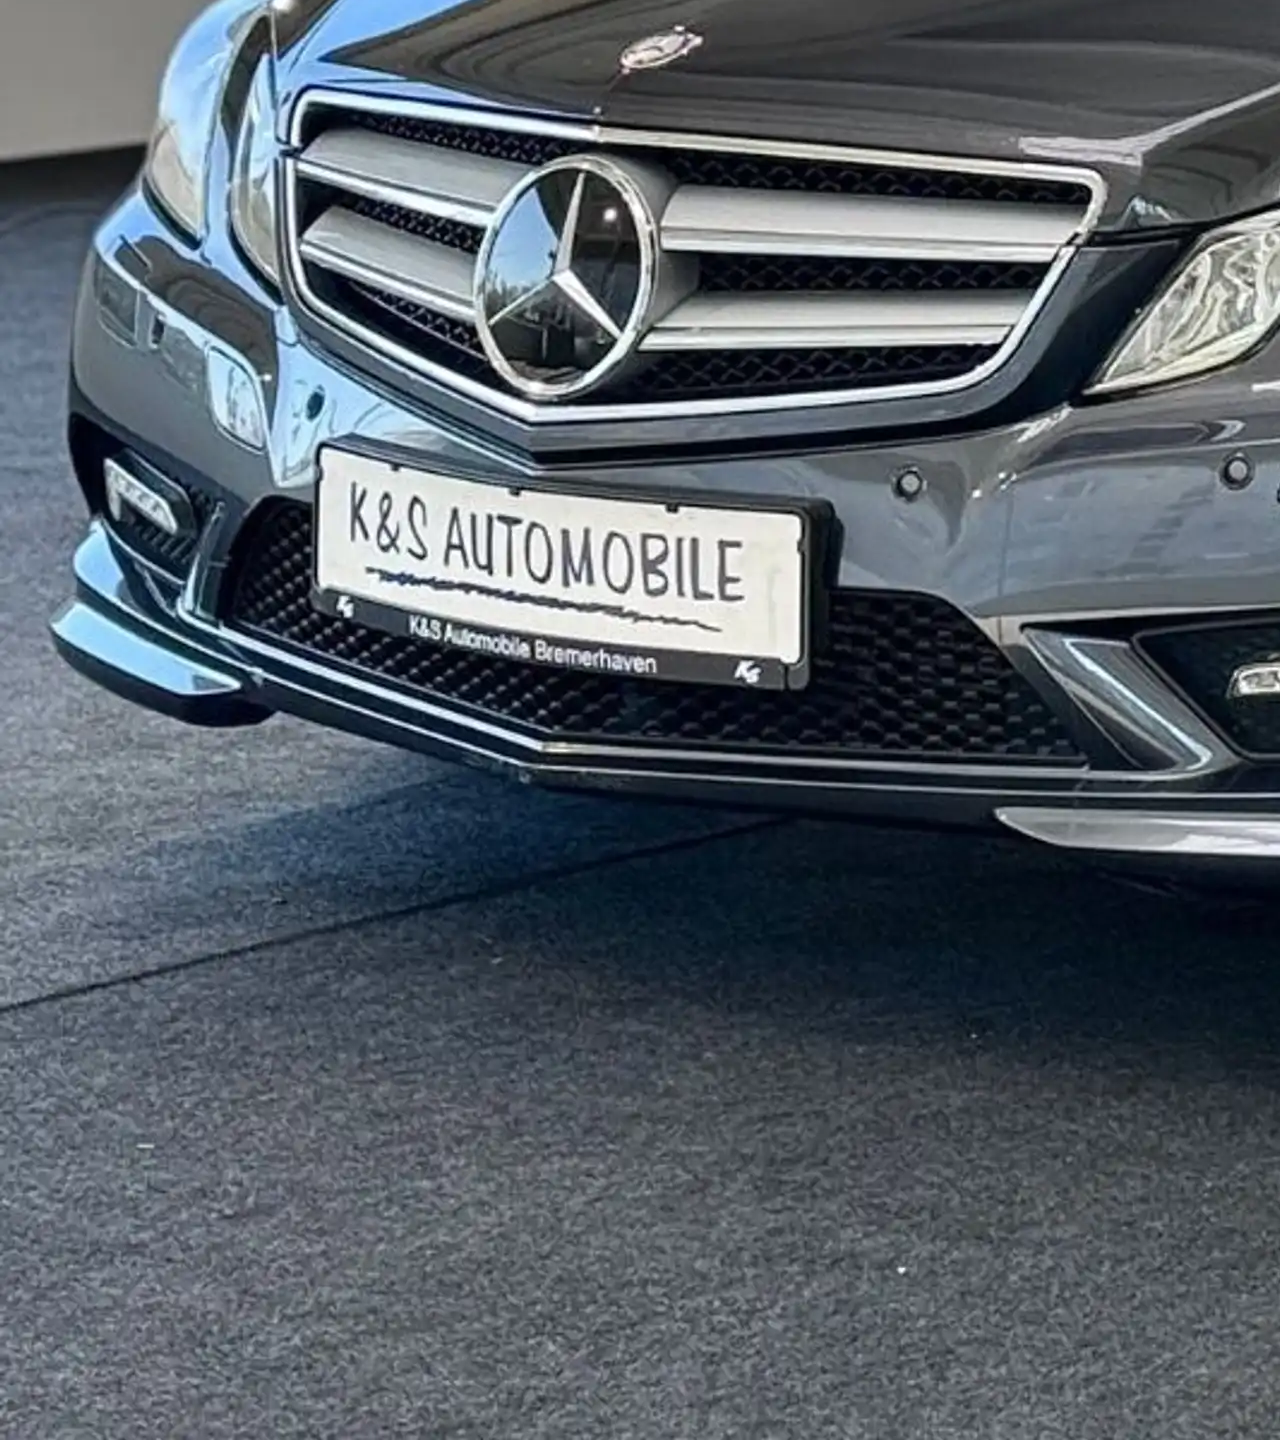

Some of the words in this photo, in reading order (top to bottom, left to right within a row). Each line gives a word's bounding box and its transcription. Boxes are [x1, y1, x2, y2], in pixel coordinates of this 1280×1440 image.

[350, 481, 428, 560] K&S
[444, 507, 745, 602] AUTOMOBILE
[409, 615, 442, 640] K&S
[444, 623, 531, 658] Automobile
[534, 640, 657, 673] Bremerhaven
